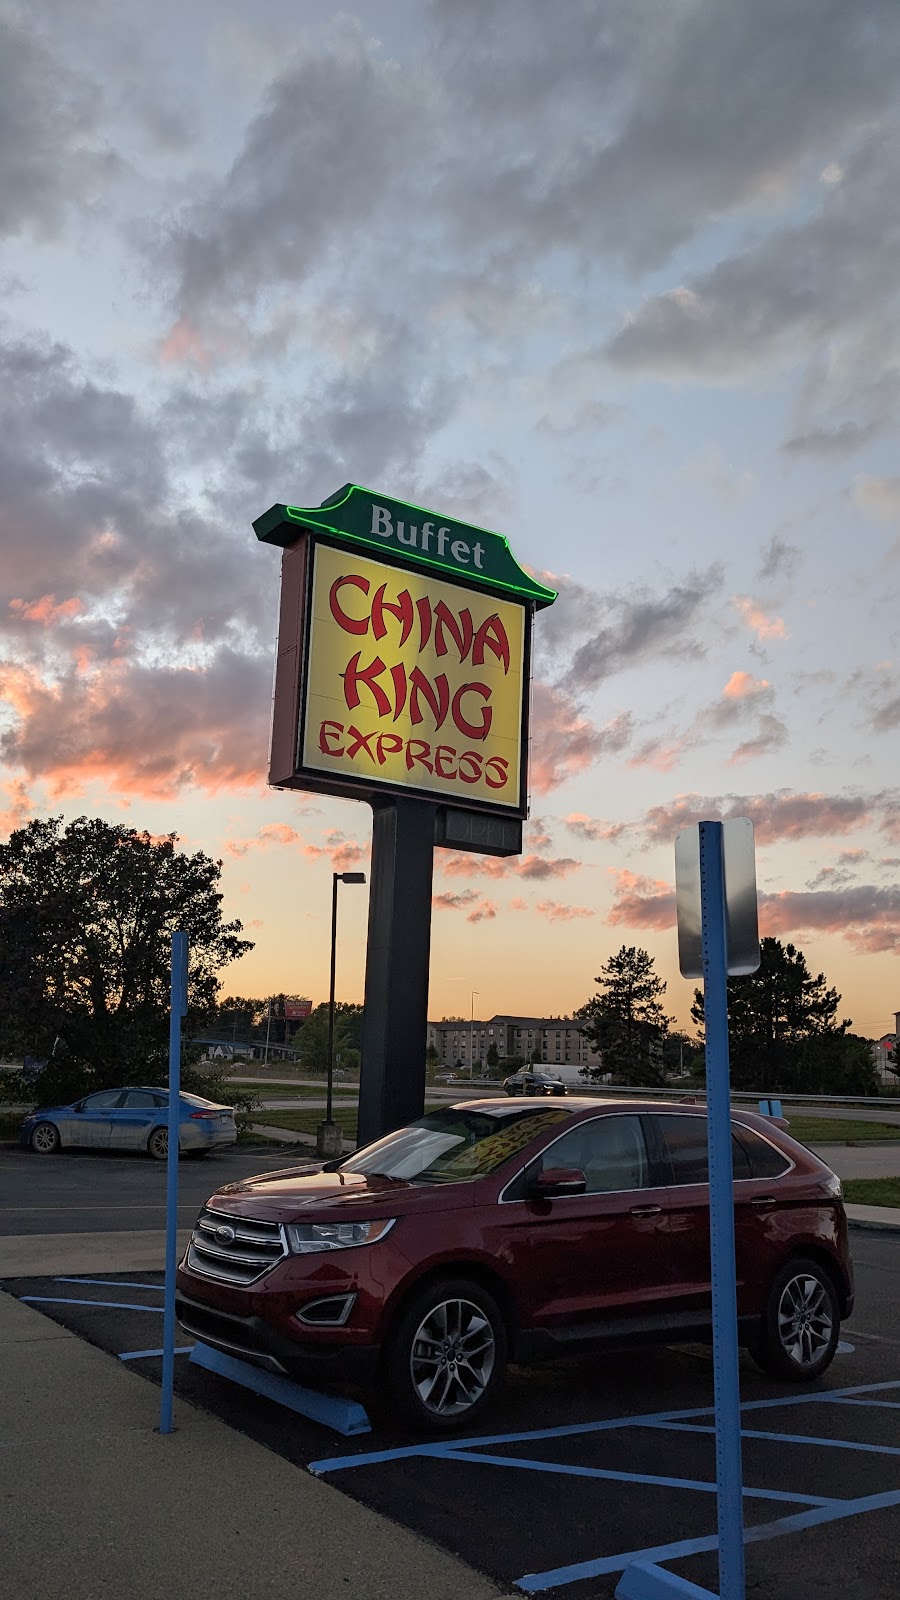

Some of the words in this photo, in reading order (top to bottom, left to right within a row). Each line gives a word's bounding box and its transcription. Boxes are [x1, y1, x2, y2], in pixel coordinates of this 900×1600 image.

[370, 504, 485, 569] Buffet
[329, 574, 510, 675] CHINA
[338, 651, 493, 742] KING
[317, 720, 509, 789] EXPRESS
